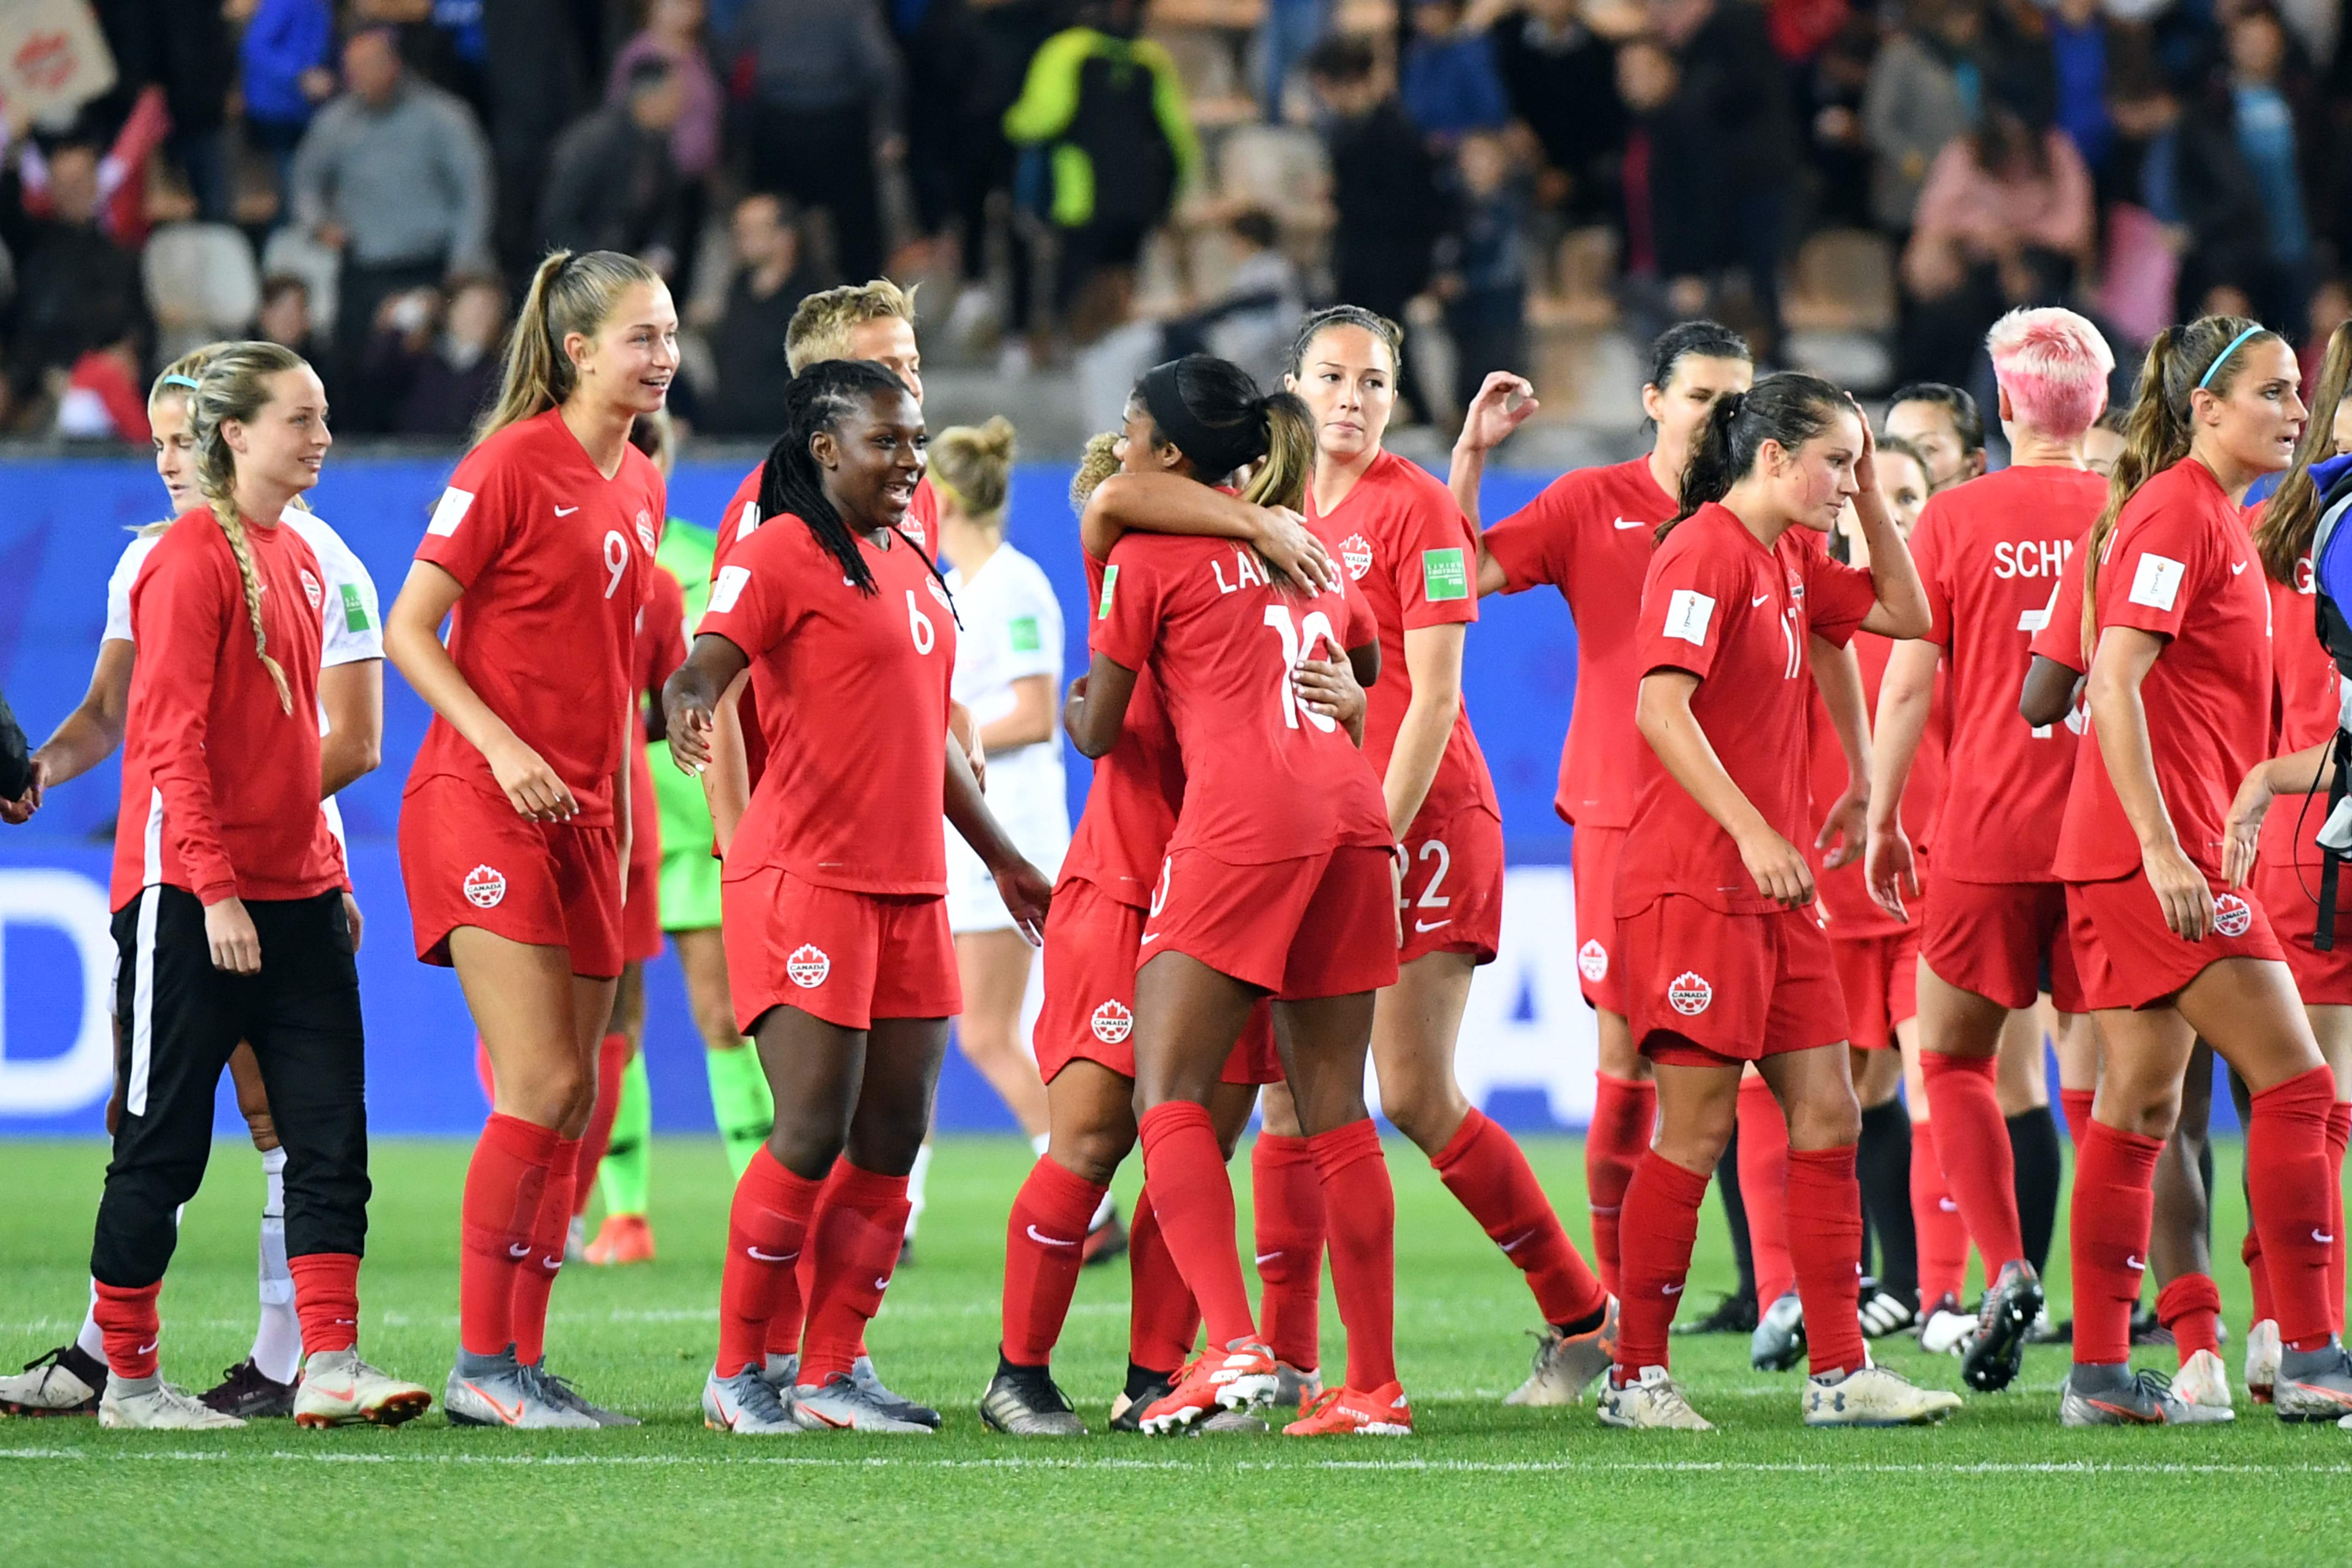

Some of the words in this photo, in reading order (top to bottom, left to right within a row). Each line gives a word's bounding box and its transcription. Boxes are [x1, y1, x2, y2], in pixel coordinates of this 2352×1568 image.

[604, 530, 629, 599] 9
[1993, 539, 2073, 579] SCH
[906, 590, 935, 655] 6
[467, 884, 501, 893] CANADA
[2216, 909, 2247, 922] CANADA
